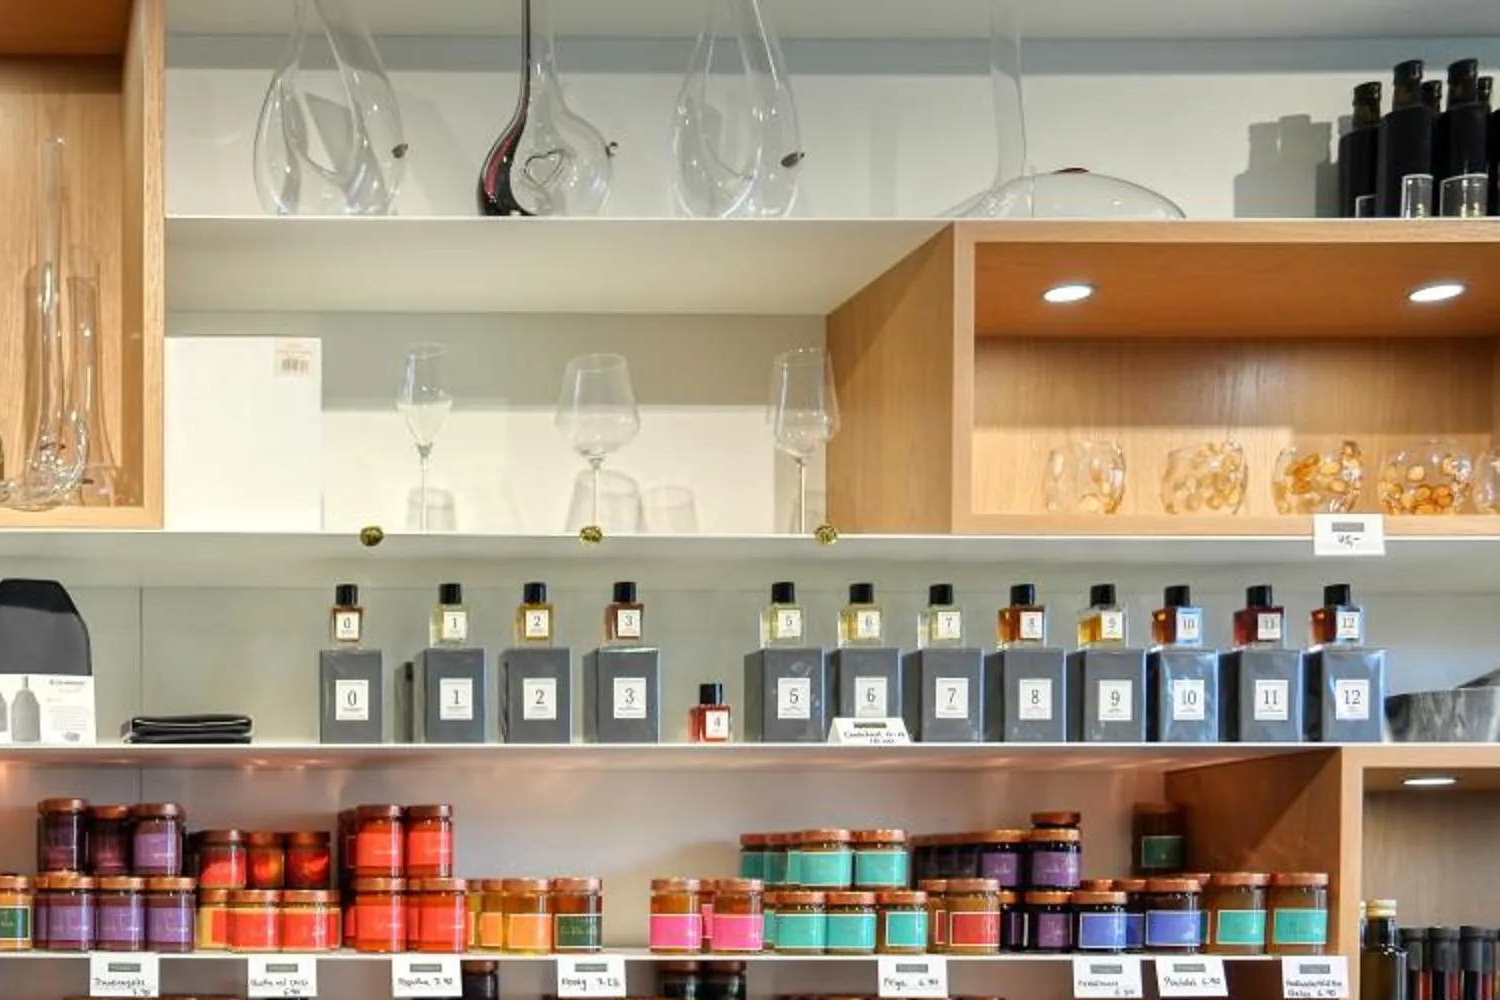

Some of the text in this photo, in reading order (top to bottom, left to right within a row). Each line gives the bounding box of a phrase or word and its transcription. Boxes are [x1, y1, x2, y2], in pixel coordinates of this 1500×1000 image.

[342, 617, 352, 632] 0
[453, 618, 457, 628] 1
[534, 616, 540, 626] 2
[625, 615, 632, 626] 3
[786, 613, 795, 626] 5
[865, 616, 872, 630] 6
[946, 616, 952, 627] 7
[1183, 616, 1194, 629] 10
[1343, 614, 1354, 628] 12
[348, 690, 356, 706] 0
[454, 690, 459, 704] 1
[536, 689, 544, 704] 2
[625, 688, 634, 704] 3
[790, 688, 798, 704] 5
[867, 688, 876, 702] 6
[948, 688, 956, 703] 7
[1032, 690, 1039, 704] 8
[1111, 690, 1120, 706] 9
[1183, 690, 1196, 705] 10
[1265, 690, 1277, 705] 11
[1344, 690, 1360, 704] 12
[714, 717, 720, 731] 4
